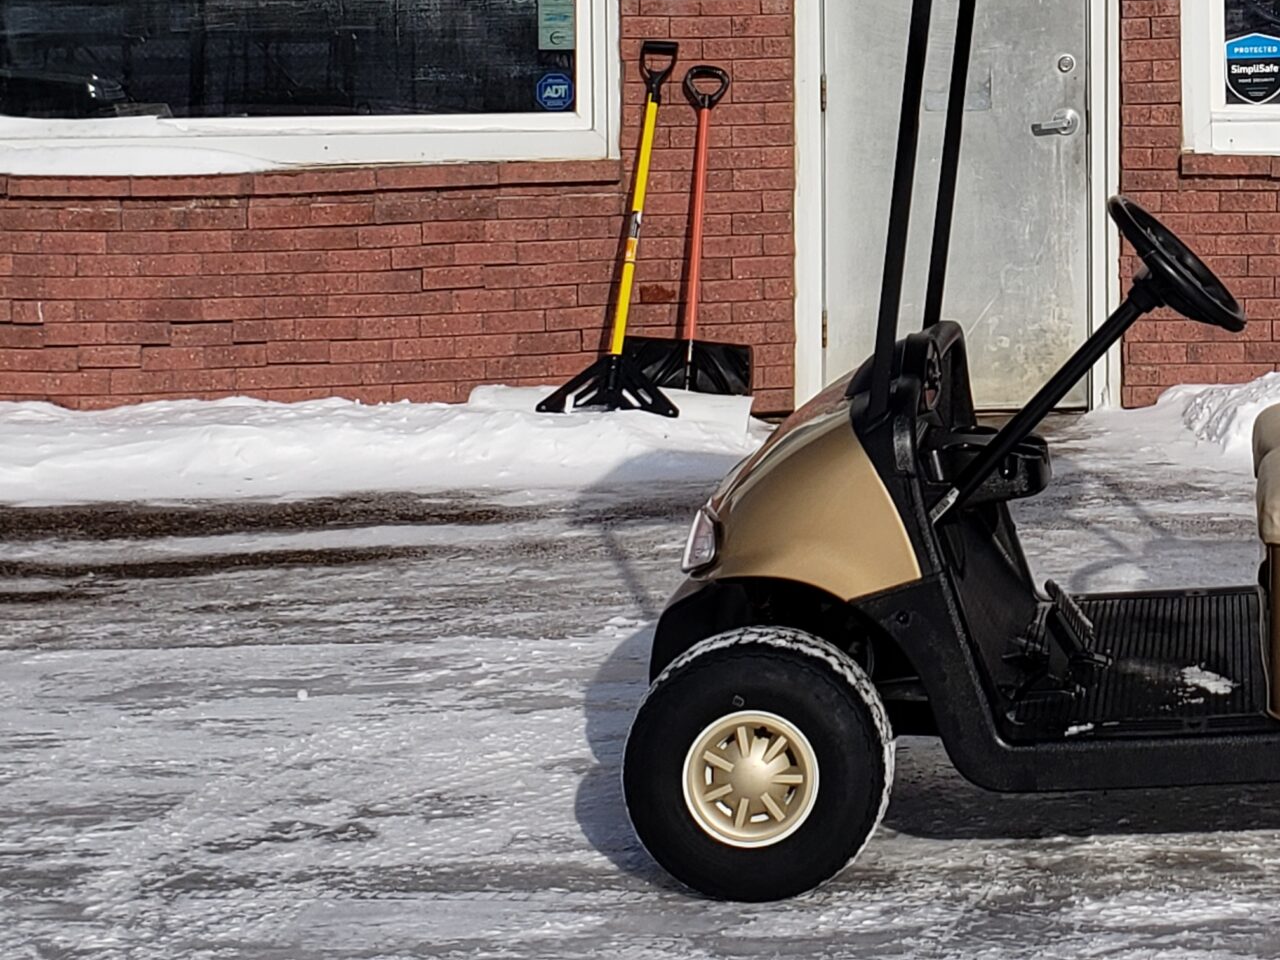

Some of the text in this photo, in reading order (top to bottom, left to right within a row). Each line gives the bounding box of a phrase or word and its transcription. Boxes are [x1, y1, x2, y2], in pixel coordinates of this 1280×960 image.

[1233, 46, 1278, 54] PROTECTED
[1231, 64, 1279, 75] SimpliSafe
[543, 85, 568, 98] ADT
